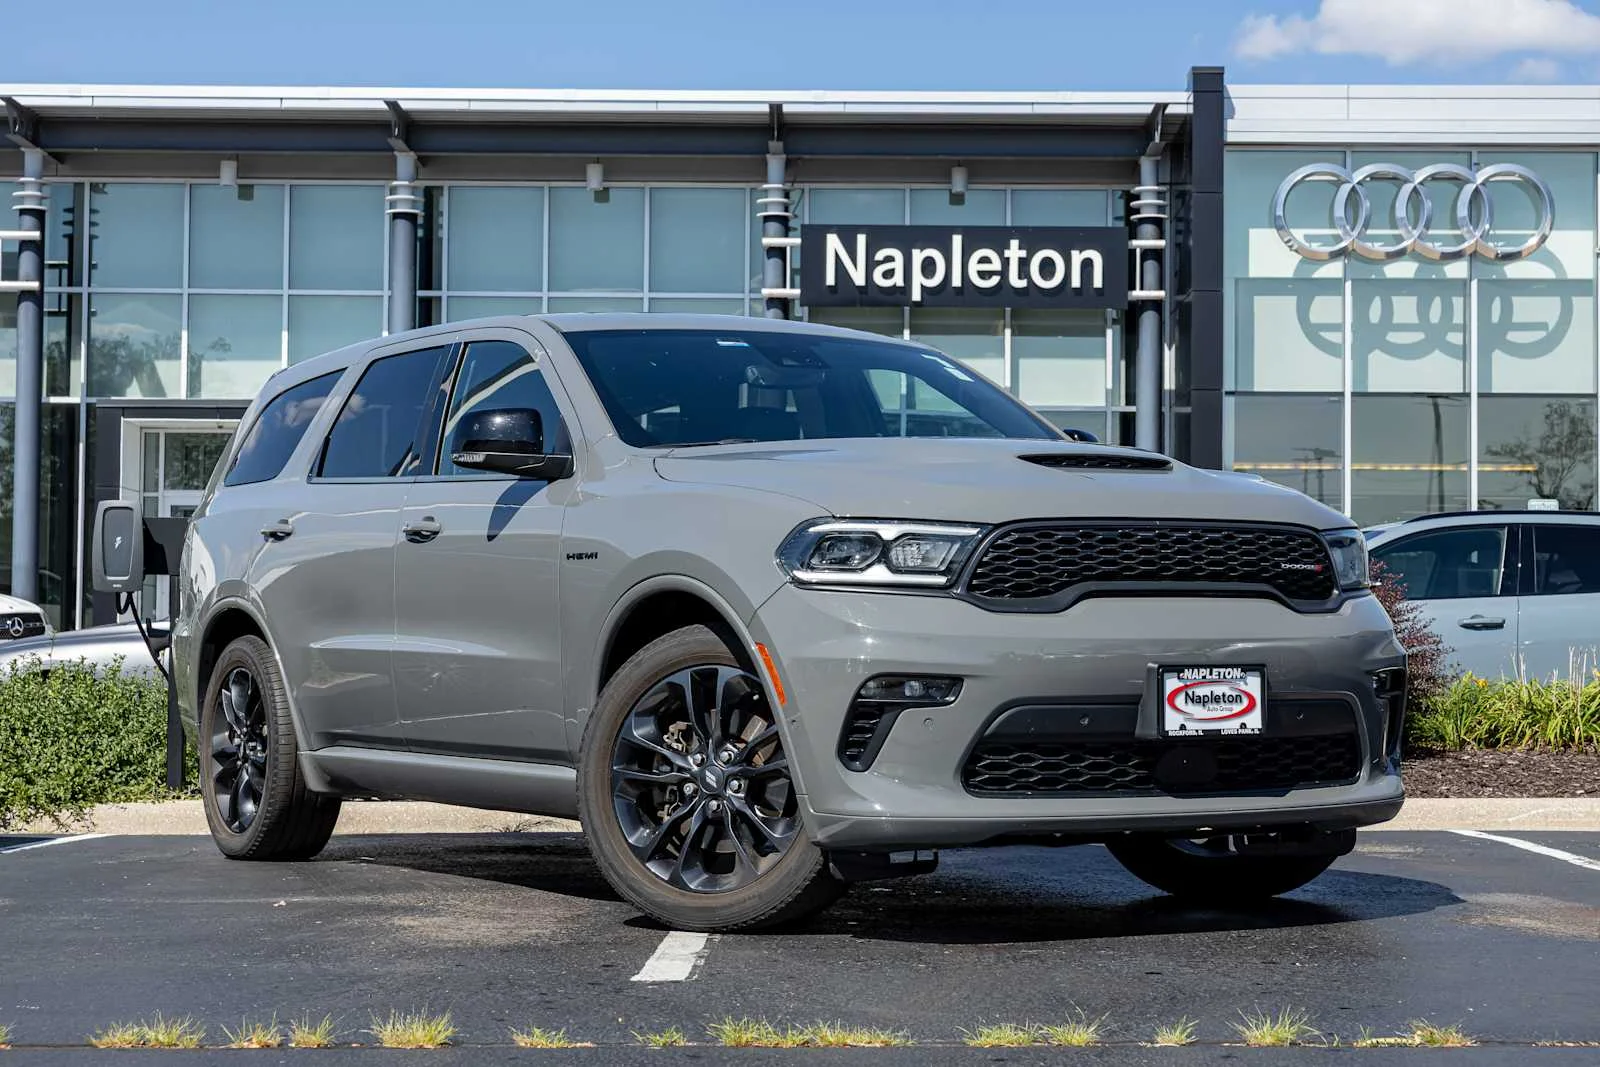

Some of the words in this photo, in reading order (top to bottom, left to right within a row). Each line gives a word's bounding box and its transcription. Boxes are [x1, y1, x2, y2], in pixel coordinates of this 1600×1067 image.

[825, 233, 1103, 301] Napleton
[566, 552, 598, 560] HEMI
[1184, 668, 1241, 679] NAPLETON
[1185, 691, 1242, 706] Napleton
